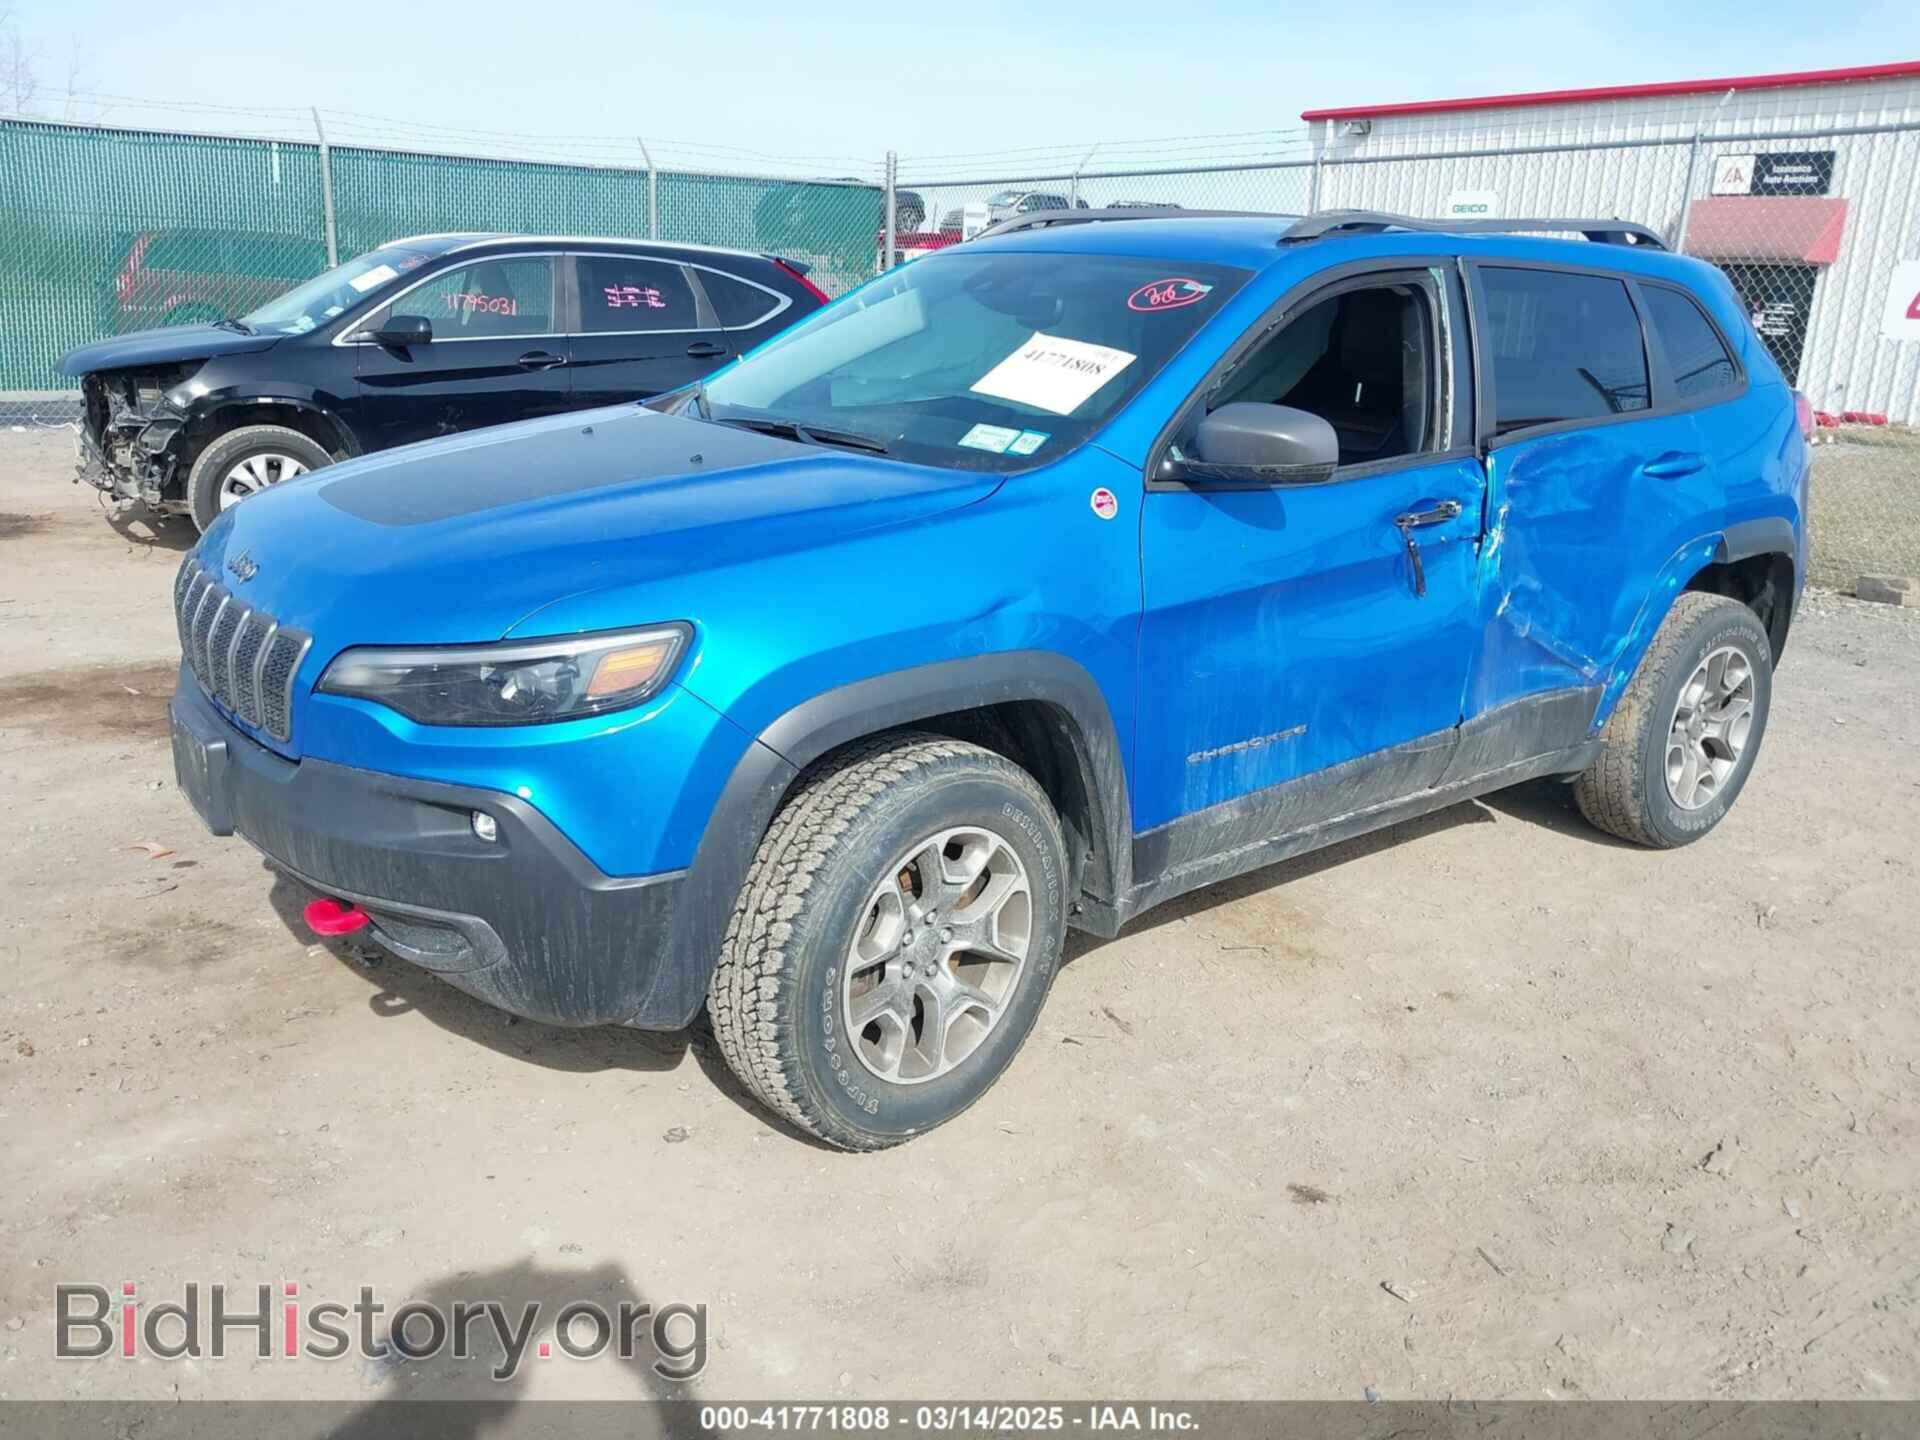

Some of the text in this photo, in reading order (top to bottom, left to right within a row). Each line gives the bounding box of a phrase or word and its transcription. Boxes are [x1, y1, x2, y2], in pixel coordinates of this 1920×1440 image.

[1452, 203, 1488, 214] GEICO
[441, 291, 517, 316] 41795031
[1023, 349, 1108, 375] 41771808
[1186, 723, 1307, 763] CHEROKEE
[1002, 802, 1060, 922] DESTINATION
